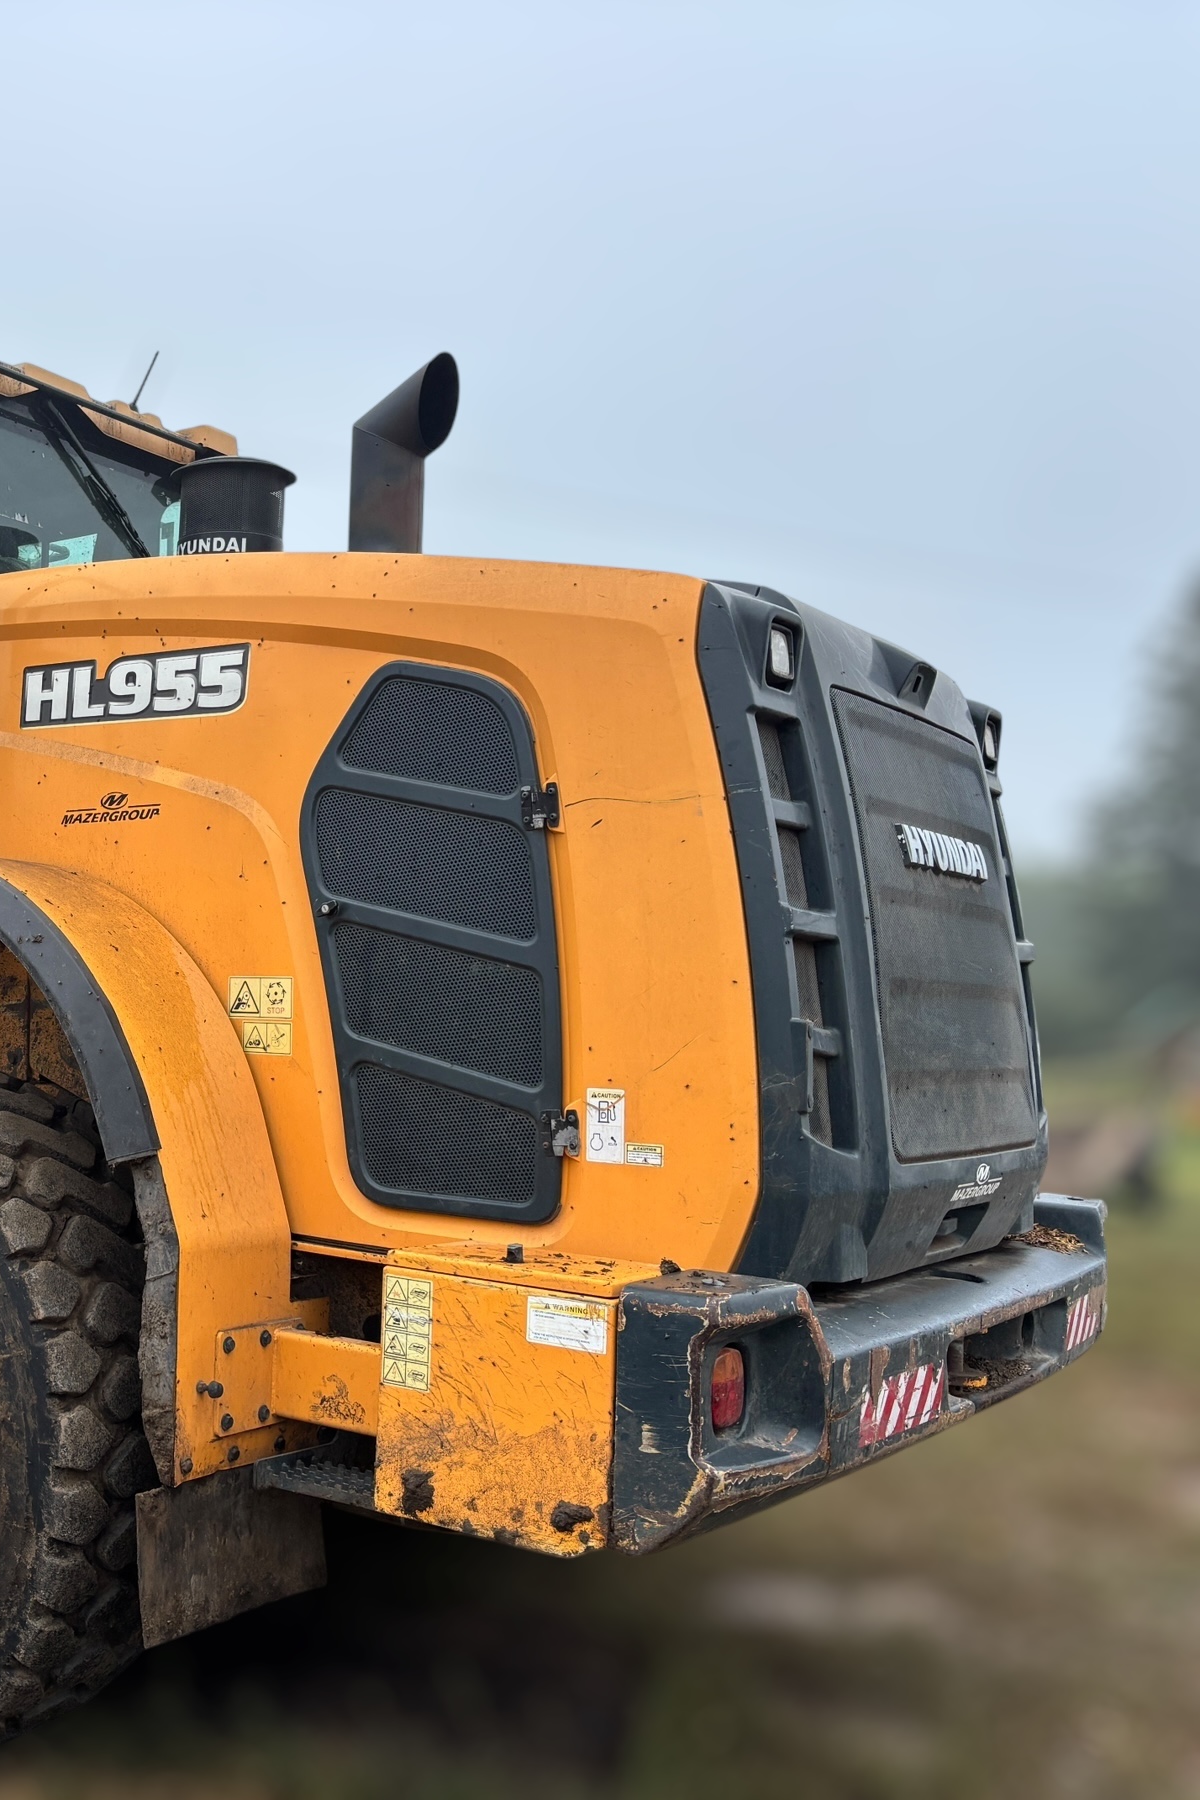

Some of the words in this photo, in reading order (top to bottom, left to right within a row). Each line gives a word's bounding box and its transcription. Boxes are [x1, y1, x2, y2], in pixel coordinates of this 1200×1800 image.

[177, 537, 247, 556] YUNDAI
[25, 649, 246, 722] HL955
[60, 808, 161, 825] MAZERGROUP
[900, 823, 988, 880] HYUNDAI
[949, 1182, 1001, 1202] MAZERGROUP
[553, 1303, 588, 1315] WARNING
